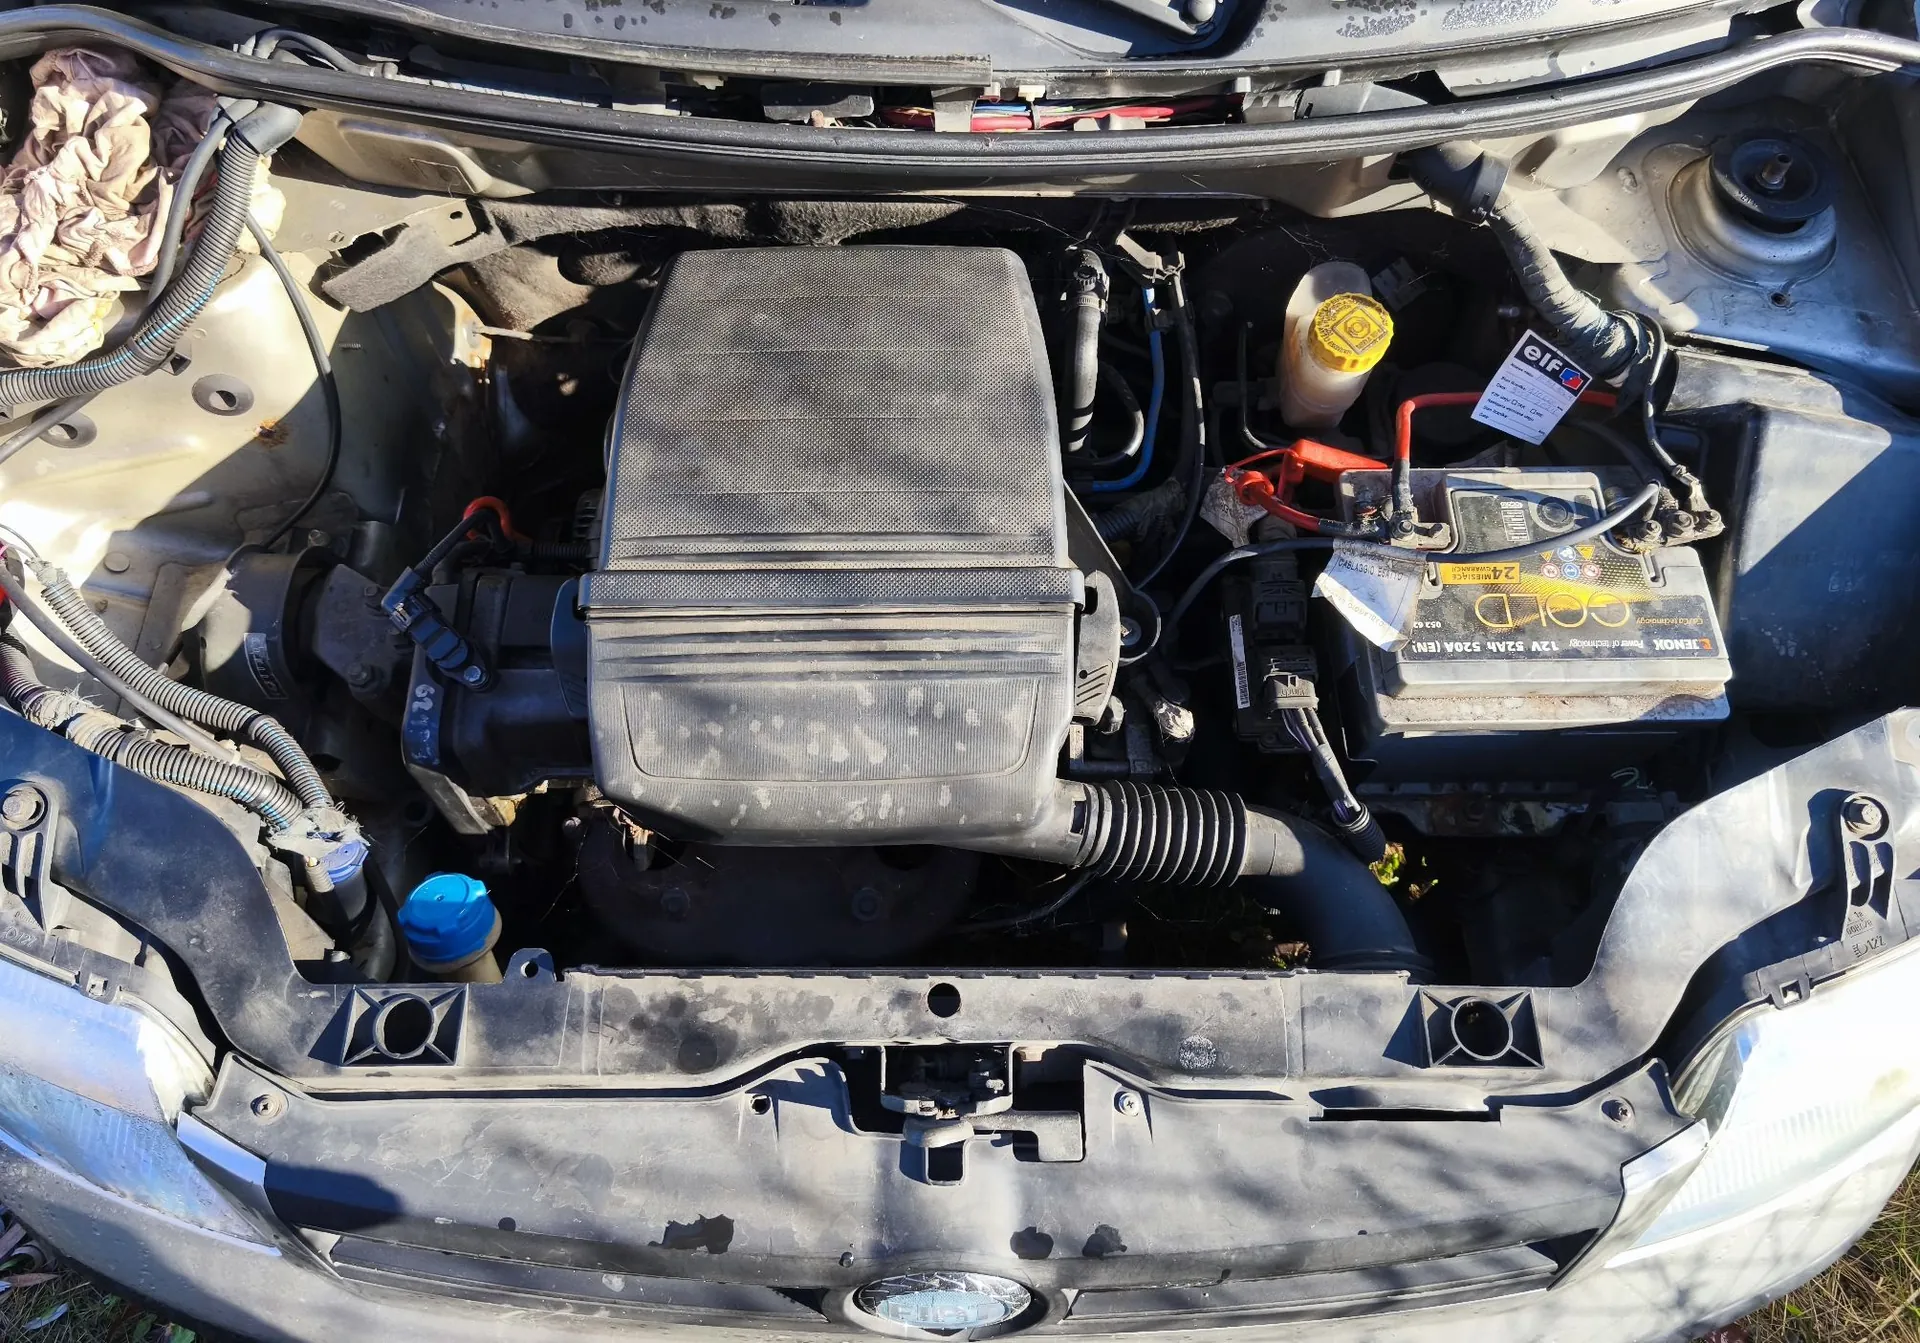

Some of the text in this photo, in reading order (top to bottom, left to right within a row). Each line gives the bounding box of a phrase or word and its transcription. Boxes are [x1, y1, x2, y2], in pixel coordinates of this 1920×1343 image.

[1524, 345, 1563, 372] elf
[1338, 558, 1374, 575] CABLAGGIO
[1491, 566, 1516, 580] 24
[1474, 590, 1631, 629] GOLD
[1636, 616, 1678, 626] technology
[1411, 640, 1559, 653] 12V 52Ah 520A (EN)
[1569, 638, 1644, 649] Power of technology
[1653, 638, 1700, 650] JENOX
